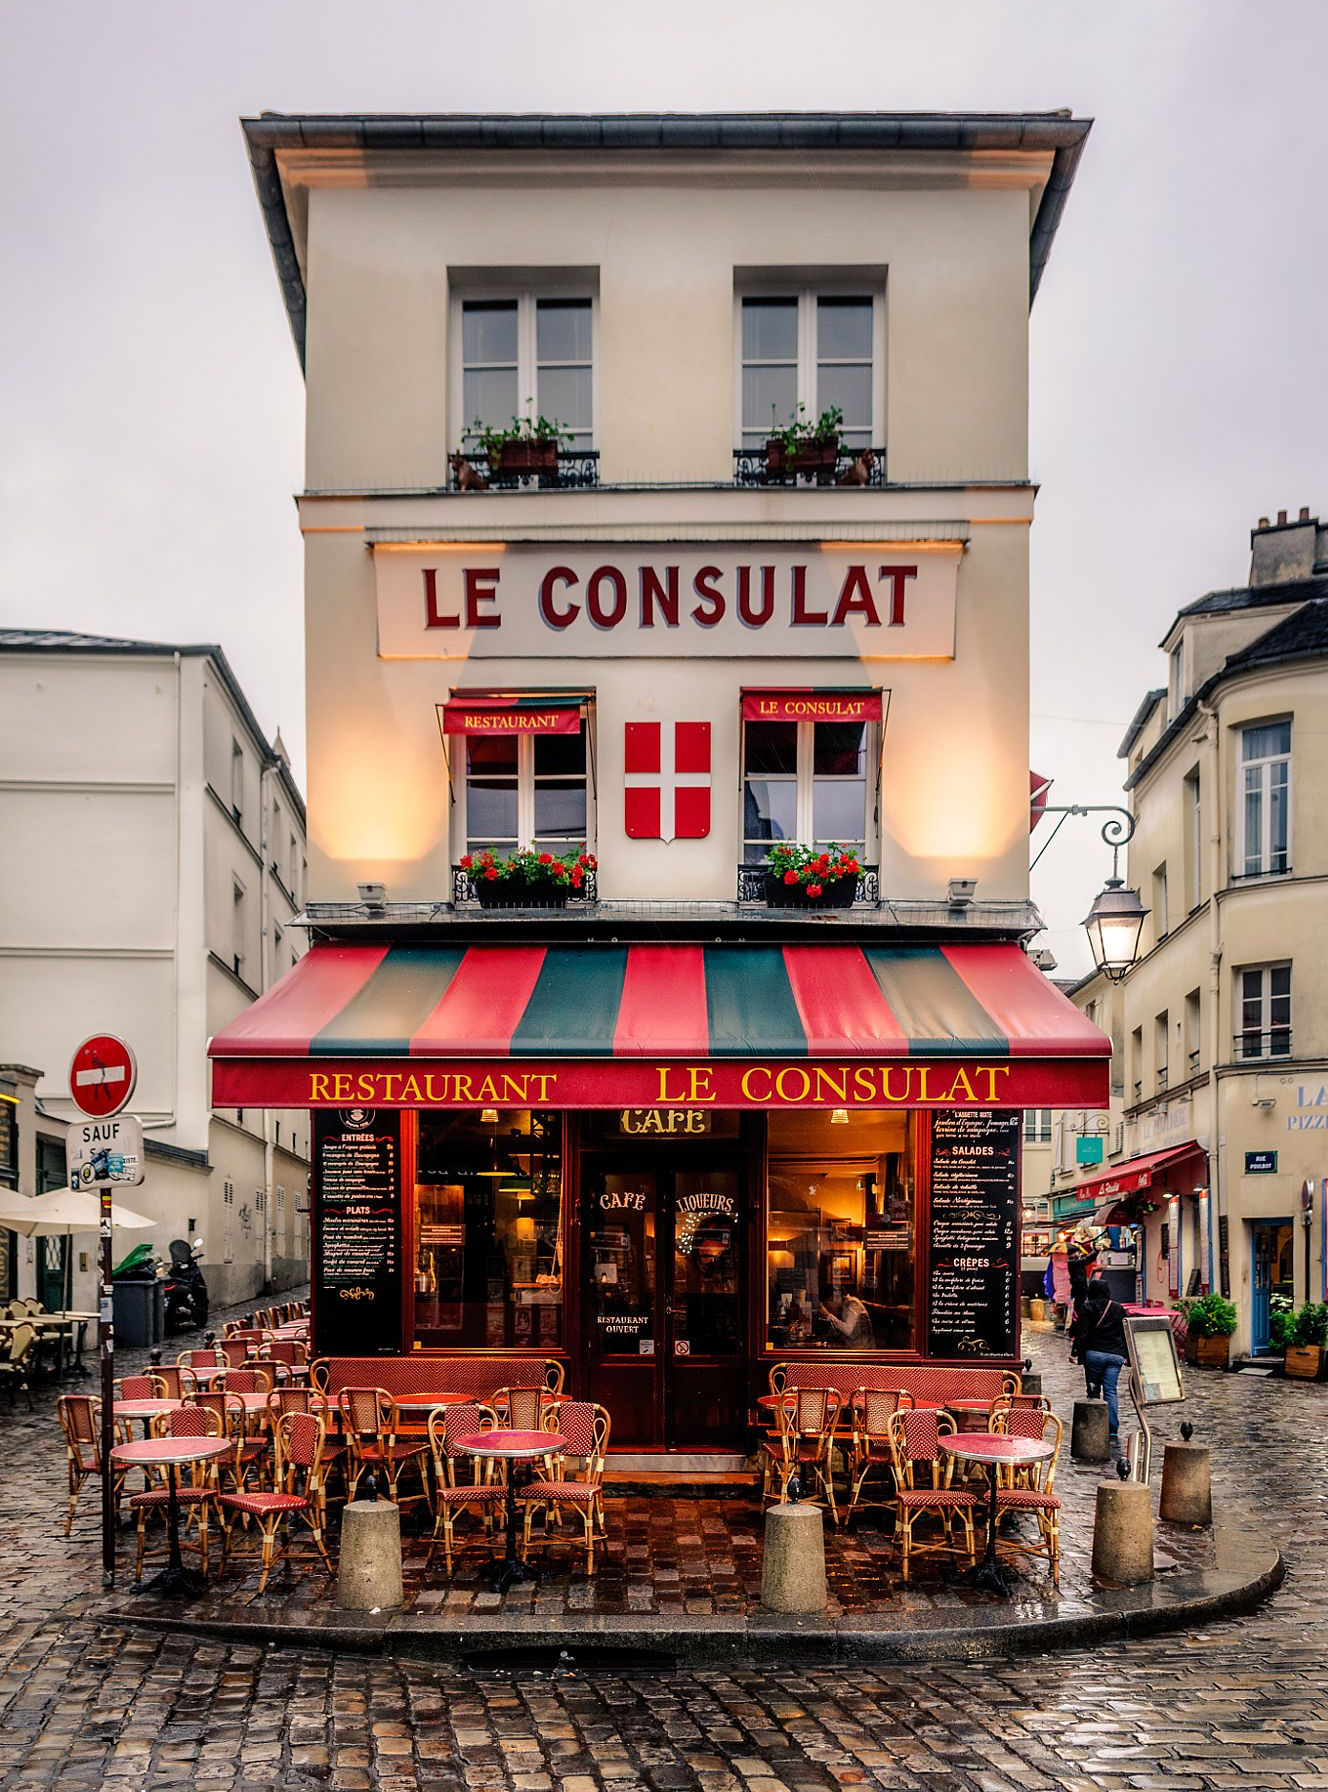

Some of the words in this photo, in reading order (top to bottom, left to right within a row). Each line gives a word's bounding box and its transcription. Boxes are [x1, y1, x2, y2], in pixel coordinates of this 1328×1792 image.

[422, 567, 502, 630] LE
[539, 566, 918, 631] CONSULAT
[760, 701, 779, 714] LE
[785, 701, 865, 714] CONSULAT
[465, 715, 559, 729] RESTAURANT
[309, 1073, 556, 1101] RESTAURANT
[656, 1067, 716, 1102] LE
[741, 1066, 1010, 1102] CONSULAT
[1288, 1115, 1328, 1130] PIZZ
[83, 1124, 120, 1143] SAUF
[952, 1146, 994, 1155] SALADES
[676, 1193, 735, 1213] LIQUEURS
[346, 1206, 370, 1215] PLATS
[954, 1257, 990, 1267] CRÊPES
[597, 1316, 649, 1324] RESTAURANT
[606, 1325, 640, 1333] OUVERT
